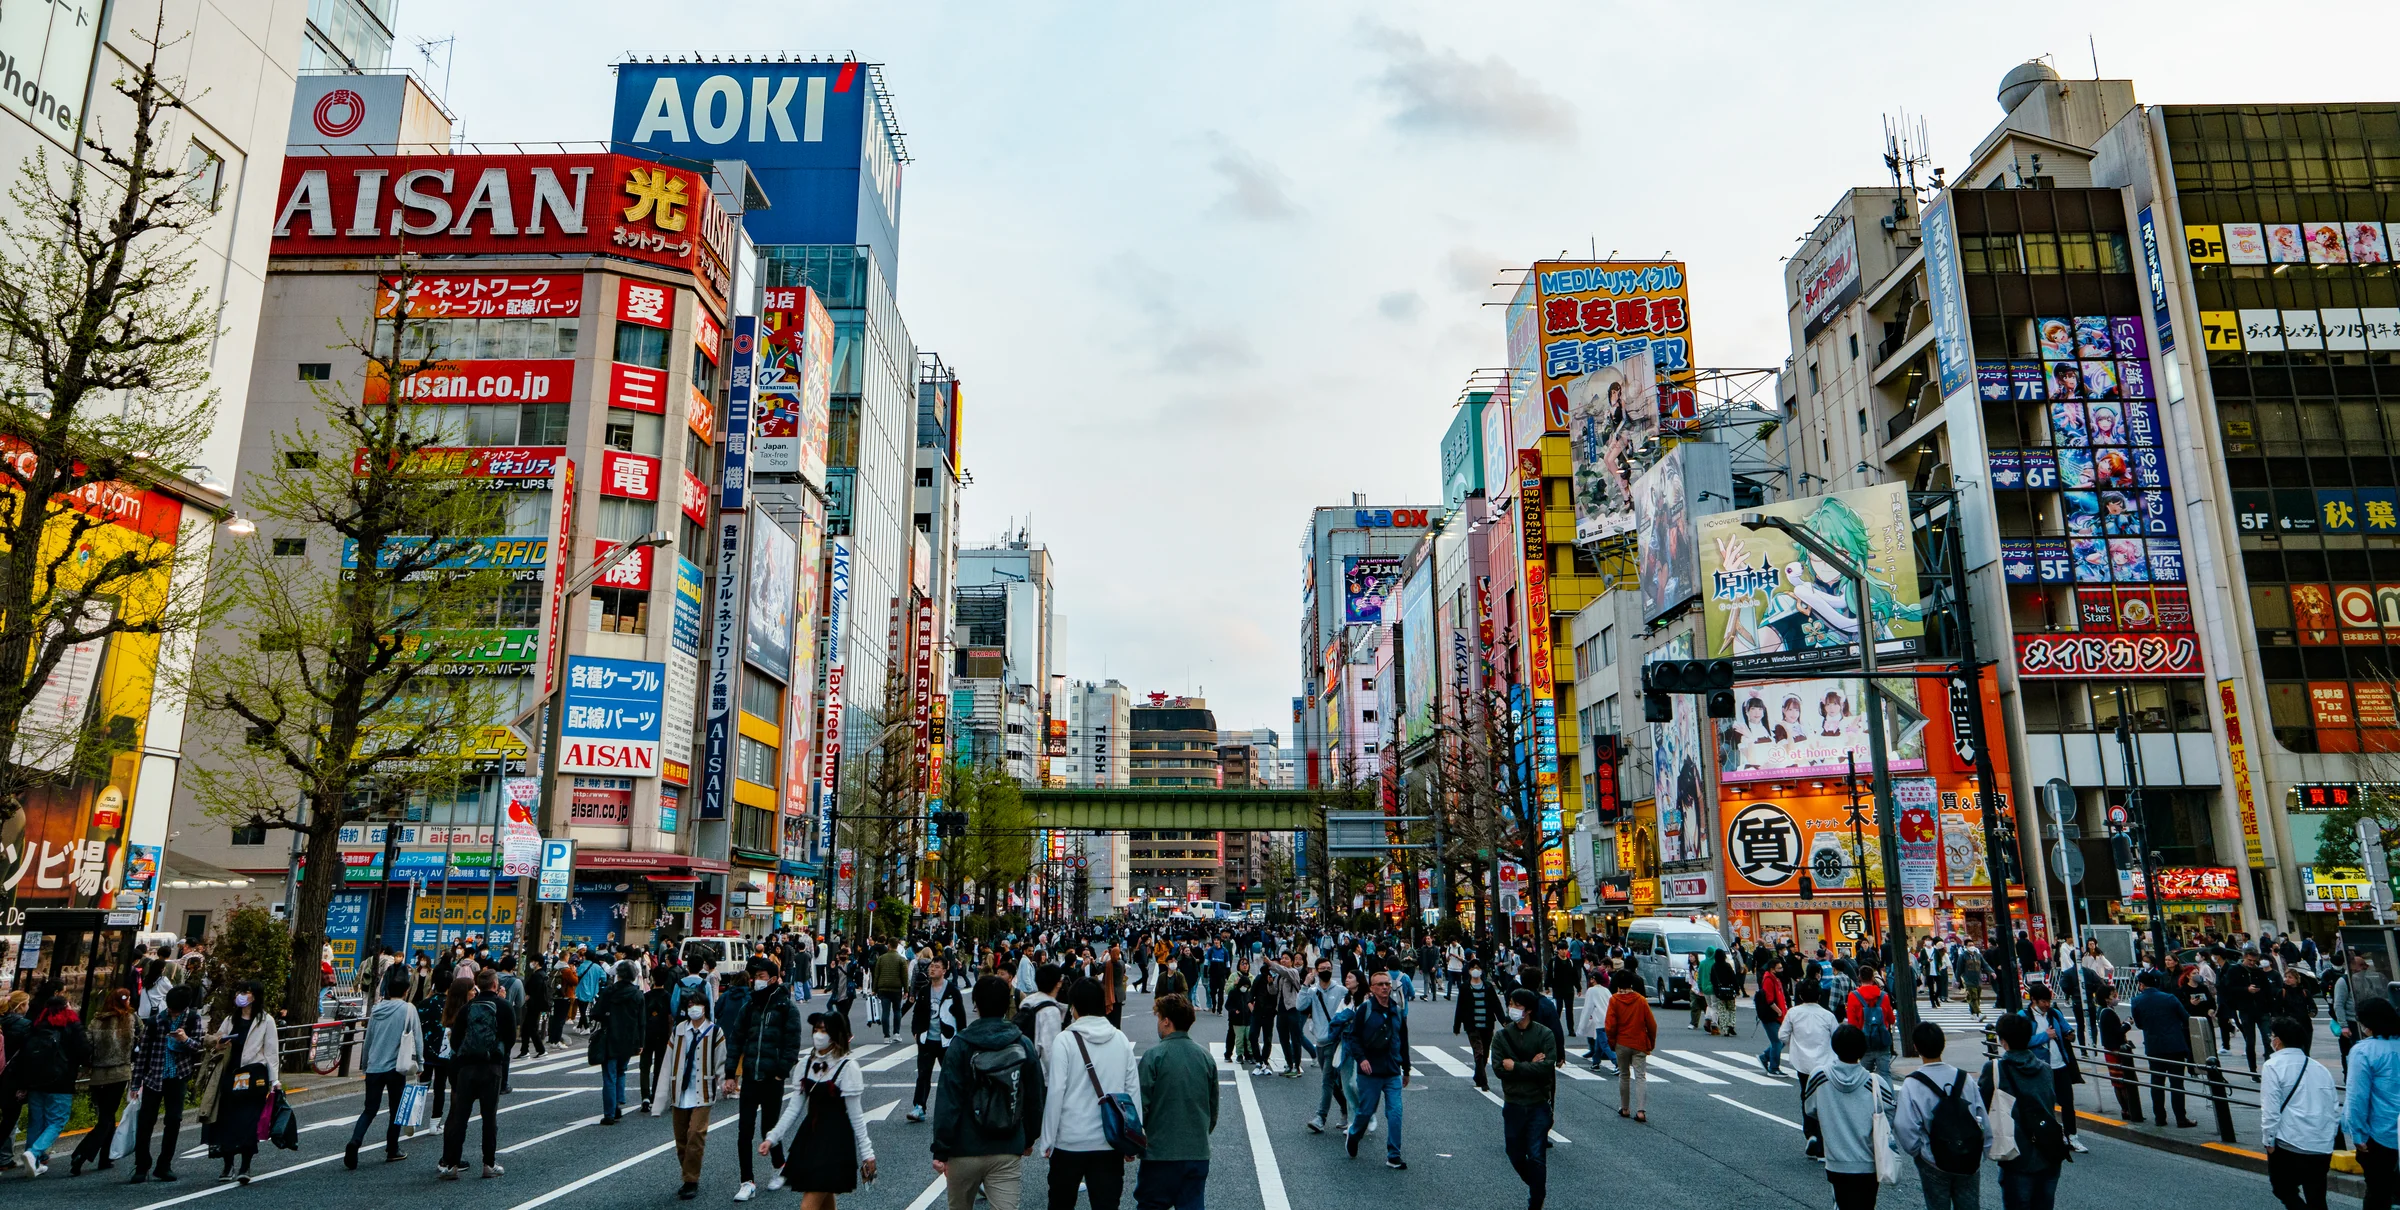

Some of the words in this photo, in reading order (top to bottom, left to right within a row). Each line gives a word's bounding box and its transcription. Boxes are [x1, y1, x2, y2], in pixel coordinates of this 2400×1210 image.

[632, 74, 827, 144] AOKI
[864, 97, 897, 228] AOKI
[272, 166, 595, 237] AISAN
[623, 166, 689, 232] 光
[613, 225, 692, 257] ネットワーク
[2188, 238, 2223, 258] 8F
[1541, 266, 1683, 295] MEDIAリサイクル
[1545, 297, 1684, 333] 激安販売
[2203, 325, 2238, 345] 7F
[724, 365, 751, 491] 愛三電機
[760, 451, 789, 459] Tax-free
[763, 442, 789, 451] Japan.
[770, 458, 788, 466] Shop
[2241, 513, 2268, 529] 5F
[2323, 501, 2397, 529] 秋葉
[833, 542, 850, 601] AKKY
[1712, 552, 1780, 612] 原神
[2154, 568, 2179, 580] 発売!
[711, 524, 739, 711] 各種ケーブル・ネットワーク機器
[829, 588, 842, 663] INTERNATIONAL
[2084, 612, 2112, 622] Stars
[1771, 654, 1797, 663] Windows
[2023, 637, 2194, 672] メイドカジノ
[571, 664, 659, 692] 各種ケーブル
[826, 664, 845, 739] Tax-free
[2318, 700, 2343, 710] Tax
[568, 704, 655, 731] 配線パーツ
[2221, 686, 2243, 745] 免税
[2318, 713, 2348, 723] Free
[564, 743, 653, 769] AISAN
[705, 722, 724, 809] AISAN
[2238, 750, 2250, 785] TAX
[2245, 789, 2259, 835] FREE
[2310, 788, 2349, 805] 買取
[571, 799, 628, 822] aisan.co.jp
[1806, 818, 1840, 829] チケット
[547, 843, 567, 867] P
[1736, 814, 1794, 877] 質
[594, 856, 658, 865] http://www.aisan.co.jp
[594, 883, 612, 891] 1949
[1674, 880, 1691, 895] COMIC
[1691, 880, 1700, 895] ZIN
[2160, 872, 2230, 888] アジア食品
[2184, 887, 2203, 895] FOOD
[1842, 915, 1863, 936] 質
